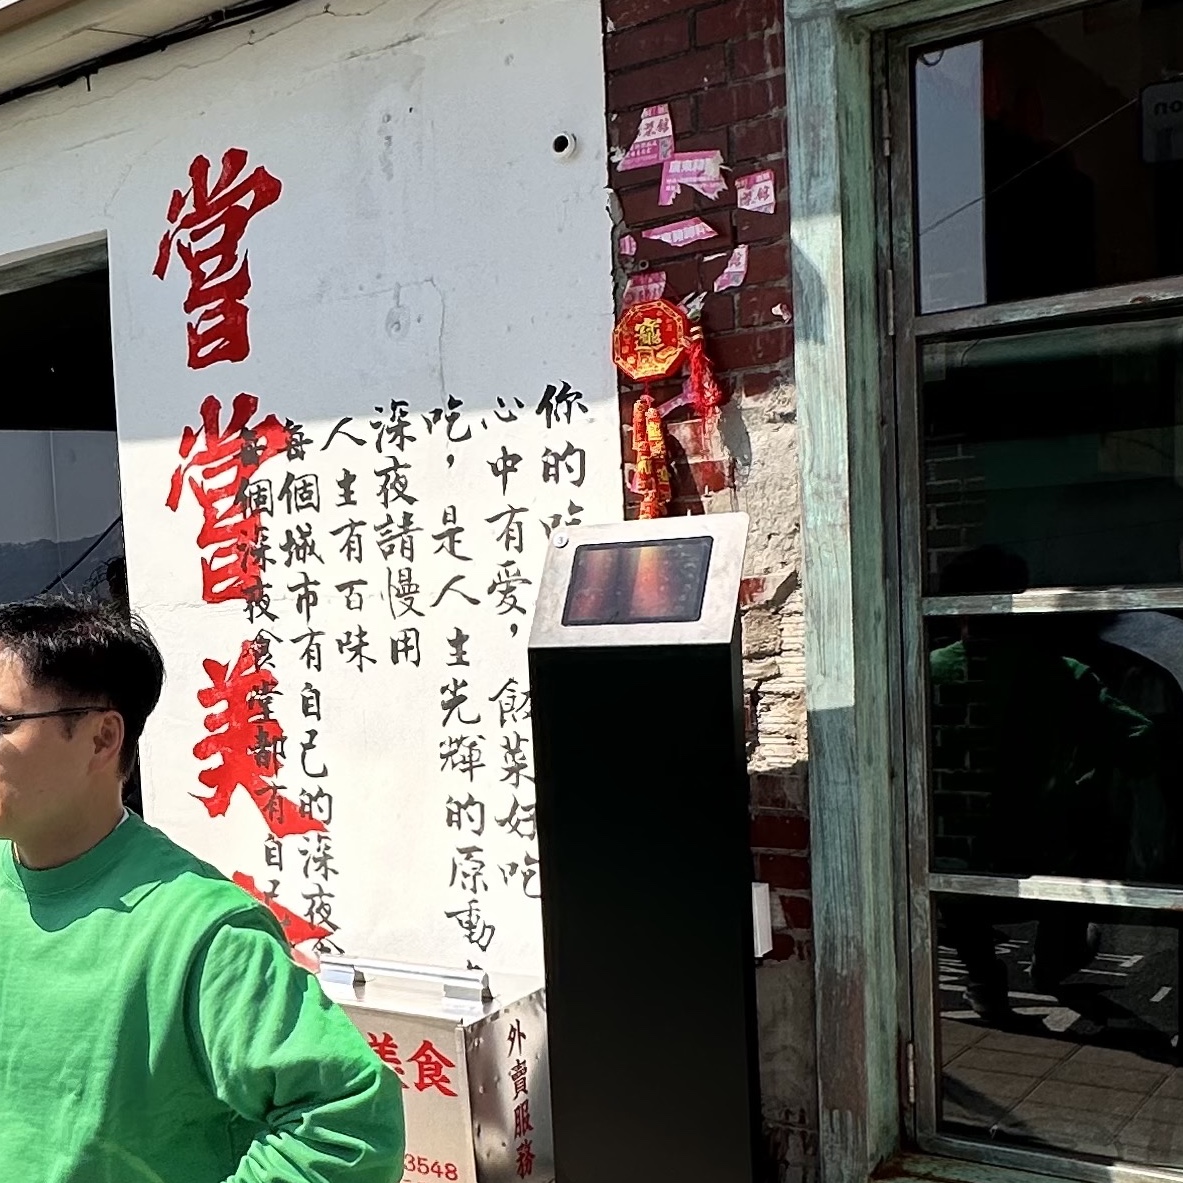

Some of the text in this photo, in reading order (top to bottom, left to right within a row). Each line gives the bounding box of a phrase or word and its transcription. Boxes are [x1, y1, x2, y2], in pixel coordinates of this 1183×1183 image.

[369, 398, 426, 668] 深夜請慢用
[423, 395, 497, 970] 吃，是人生光輝的原動
[403, 1153, 459, 1181] 3548
[506, 1018, 536, 1180] 外賣服務
